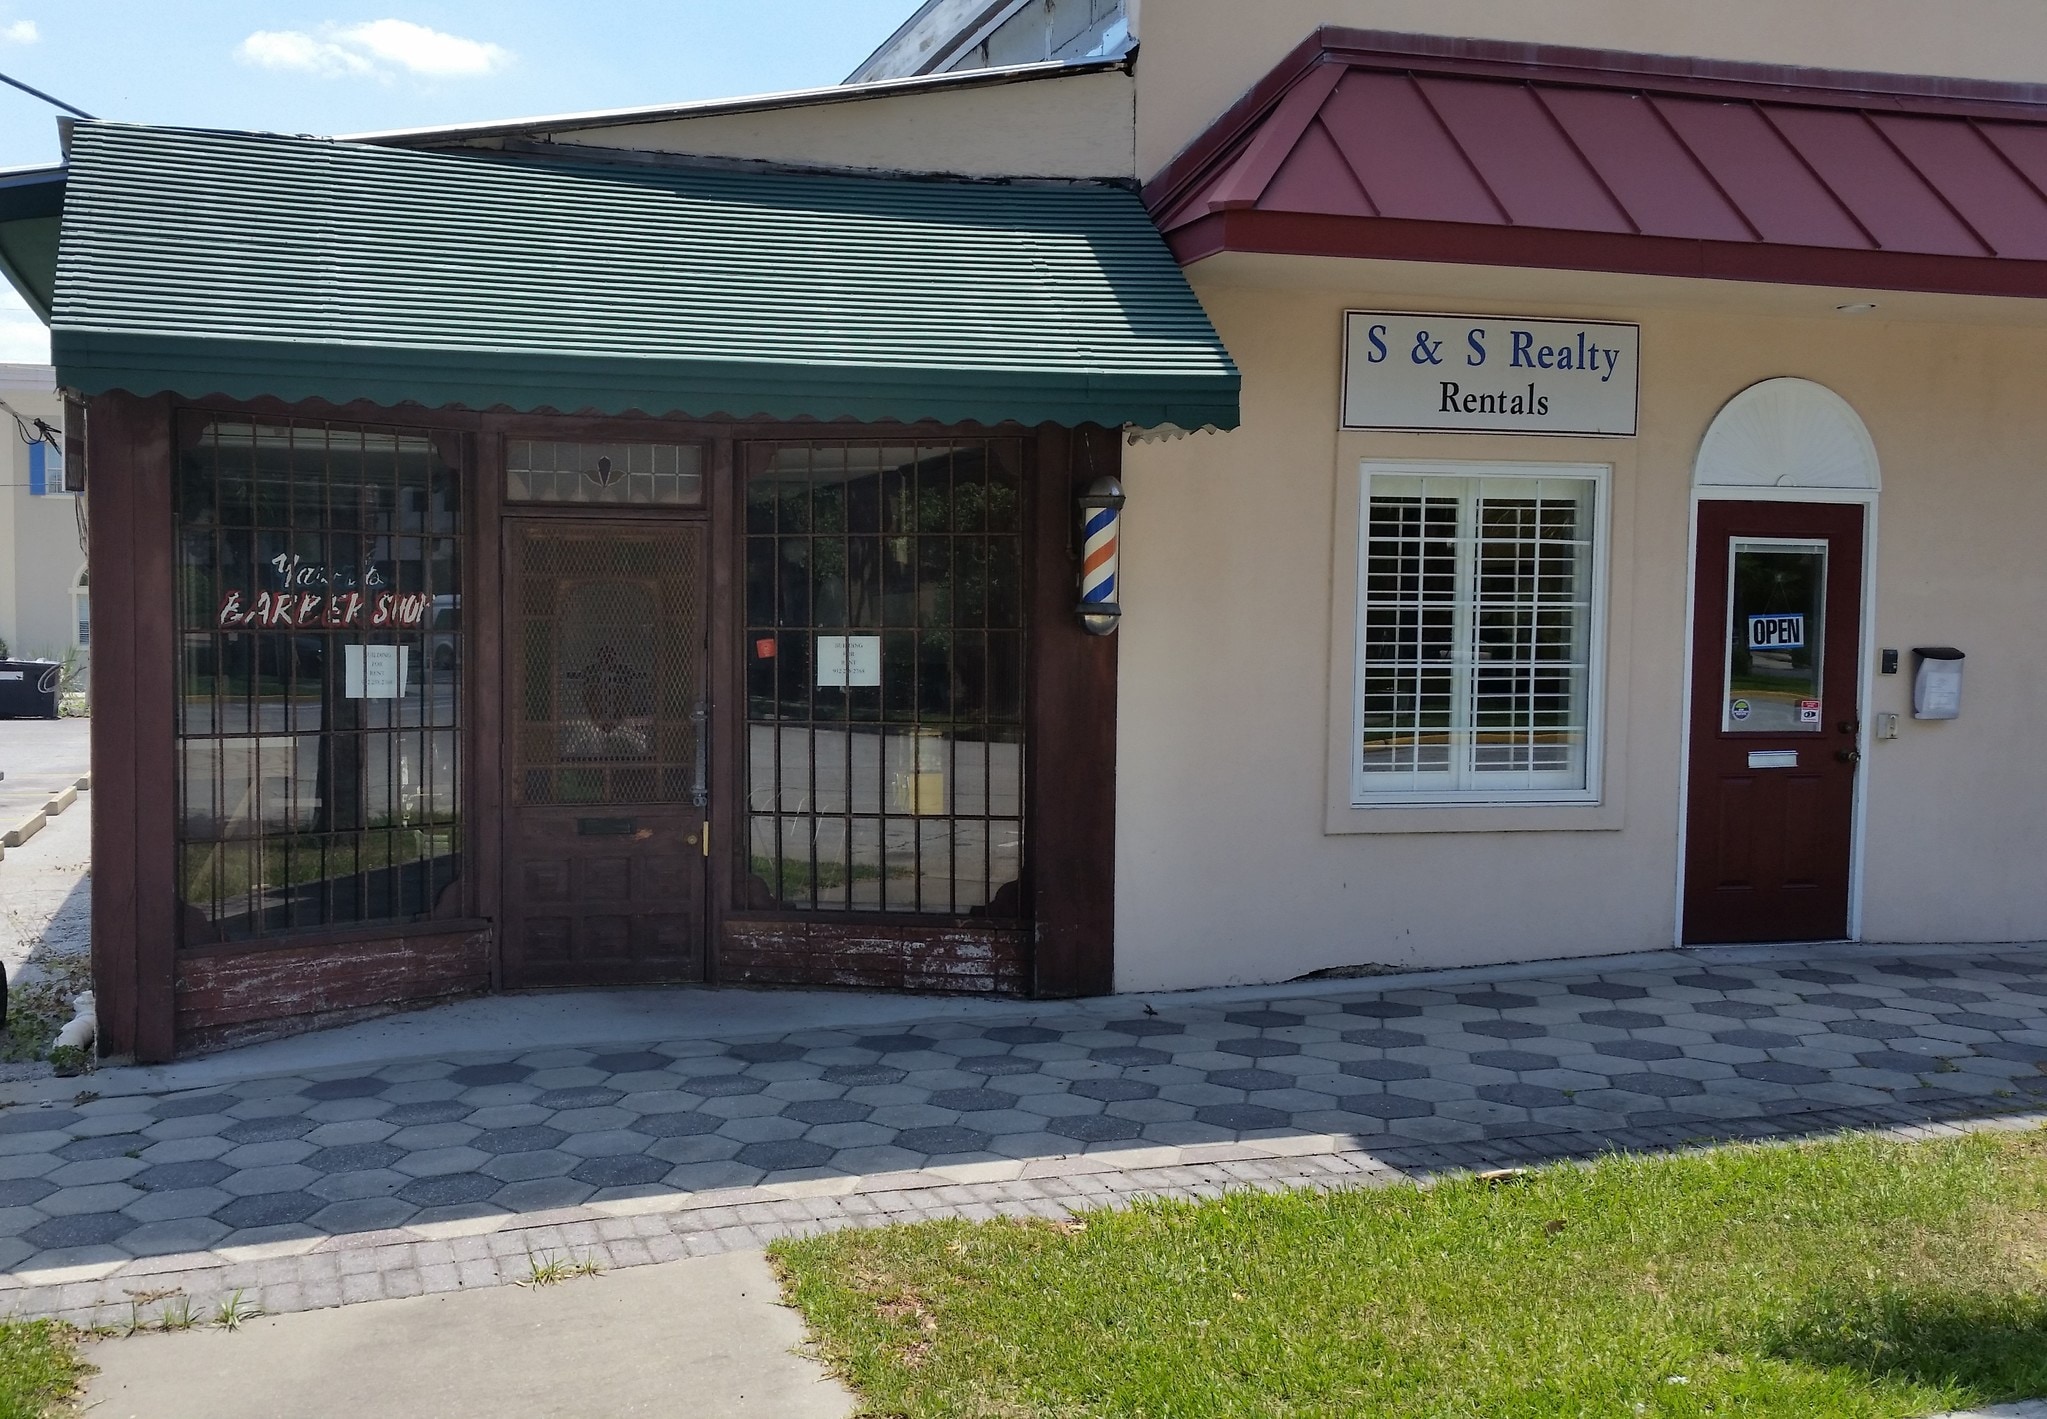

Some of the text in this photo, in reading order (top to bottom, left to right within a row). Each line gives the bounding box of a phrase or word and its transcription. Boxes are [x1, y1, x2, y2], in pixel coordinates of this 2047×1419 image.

[1367, 324, 1620, 383] S & S Realty
[1438, 381, 1550, 416] Rentals
[1753, 618, 1800, 645] OPEN
